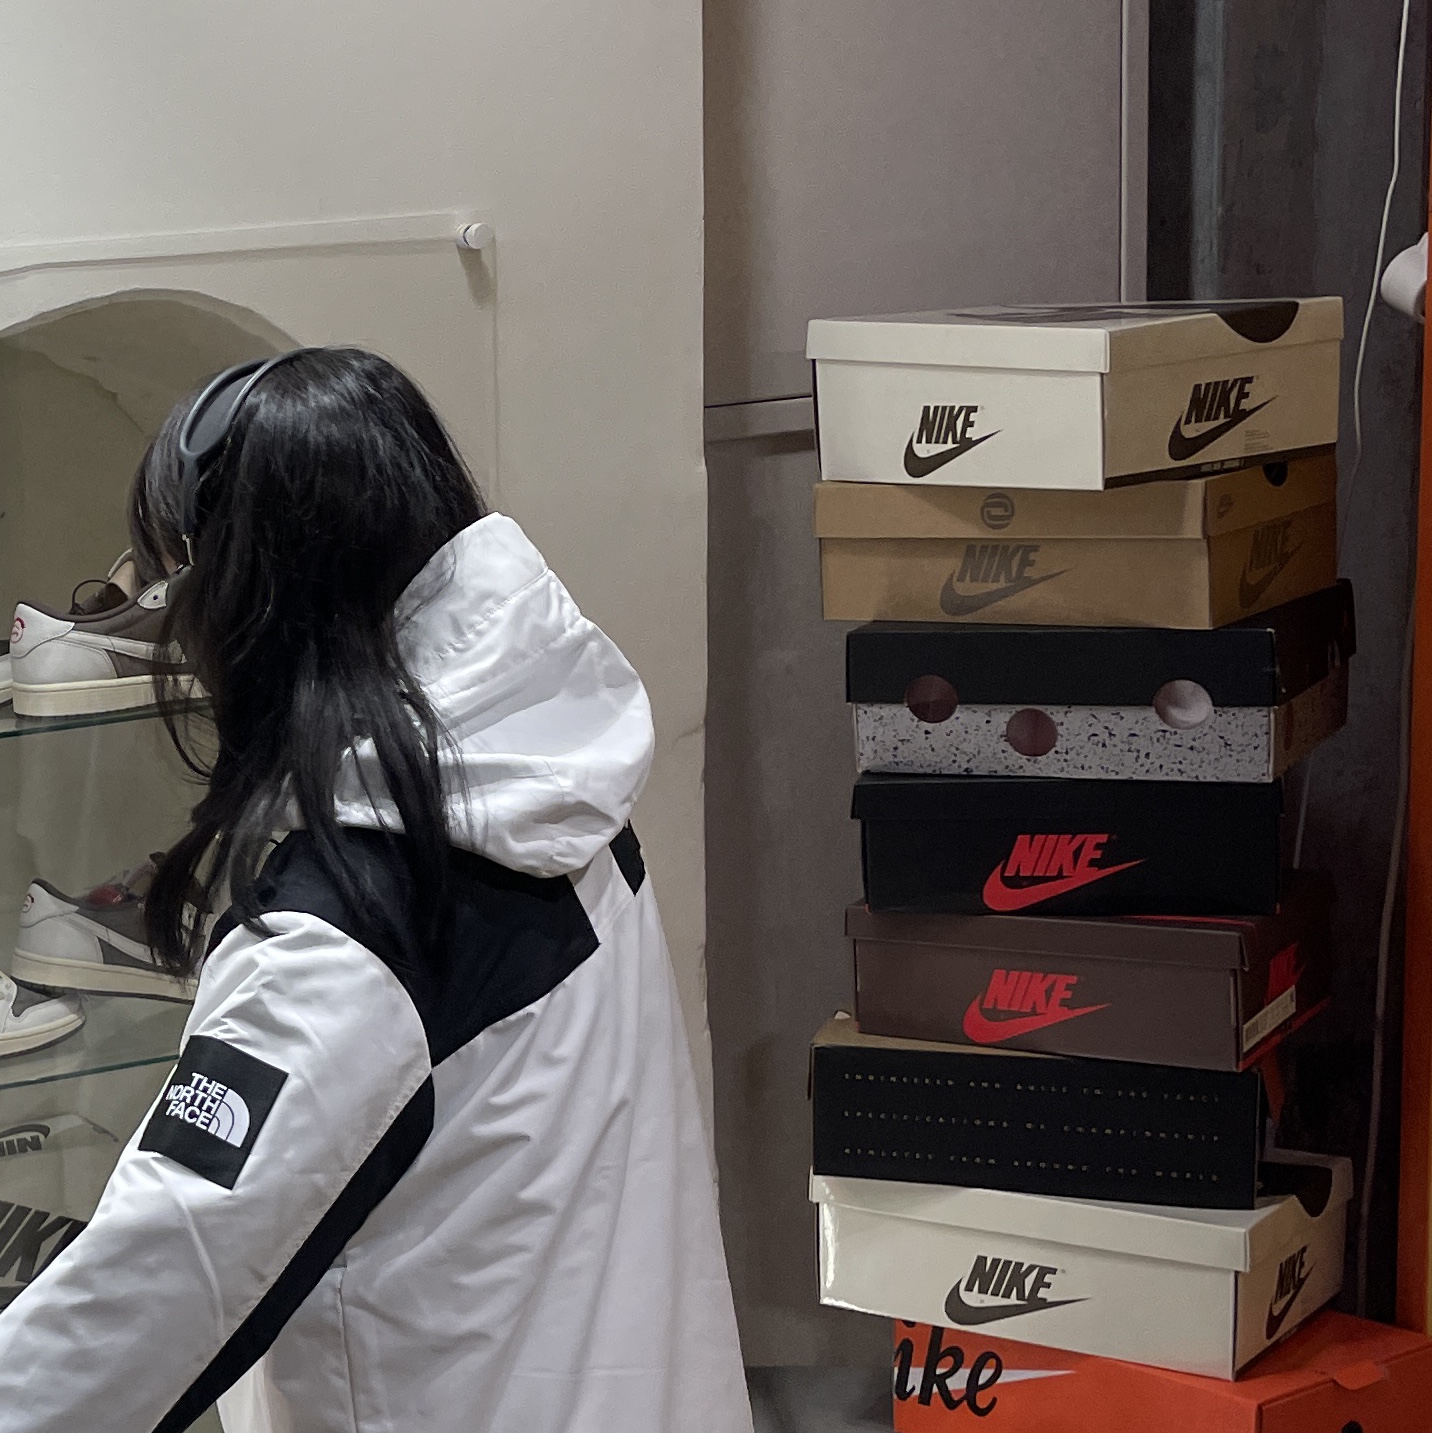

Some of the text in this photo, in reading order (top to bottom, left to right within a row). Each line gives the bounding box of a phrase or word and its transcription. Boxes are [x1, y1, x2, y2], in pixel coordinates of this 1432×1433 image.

[1184, 376, 1255, 426] NIKE
[915, 405, 979, 445] NIKE
[956, 544, 1041, 584] NIKE
[1004, 834, 1110, 877] NIKE
[981, 969, 1078, 1012] NIKE
[165, 1084, 219, 1115] NORTH
[190, 1072, 228, 1100] THE
[165, 1100, 214, 1131] FACE
[965, 1255, 1058, 1302] NIKE
[1274, 1245, 1309, 1305] NIKE
